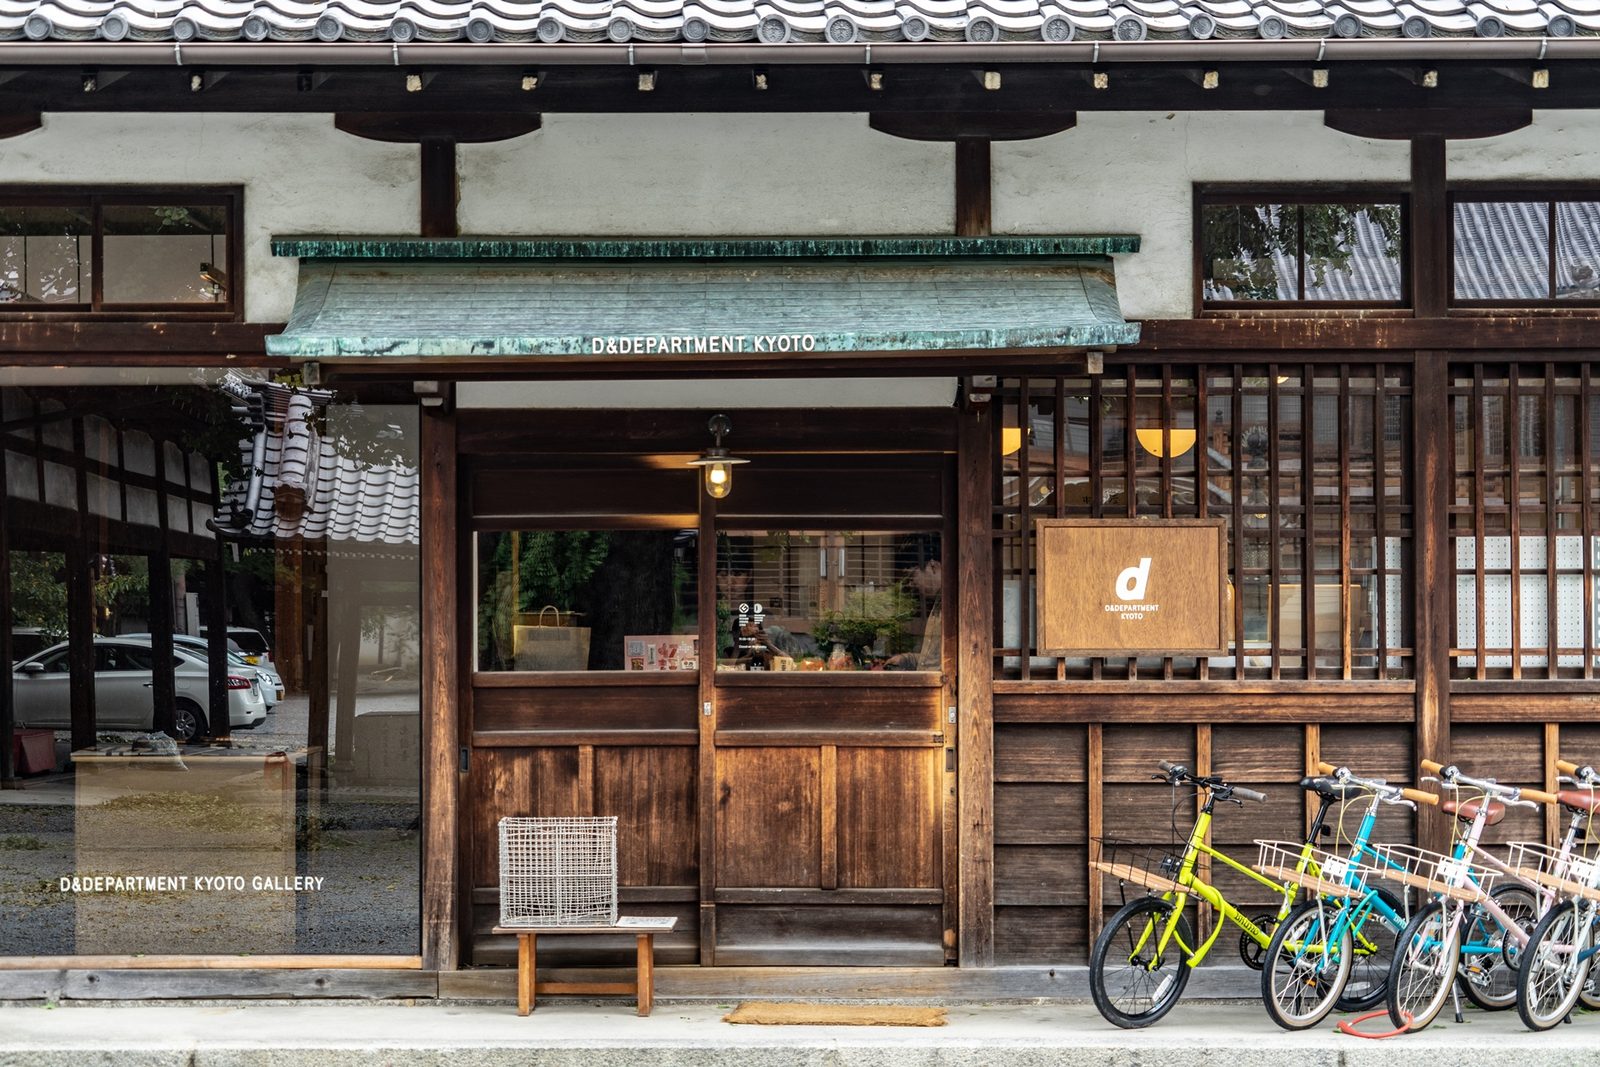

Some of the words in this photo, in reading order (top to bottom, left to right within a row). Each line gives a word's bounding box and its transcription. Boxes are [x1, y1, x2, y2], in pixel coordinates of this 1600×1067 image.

[591, 336, 745, 354] D&DEPARTMENT
[753, 335, 815, 352] KYOTO
[1115, 557, 1152, 600] d
[1104, 604, 1159, 612] D&DEPARTMENT
[60, 876, 188, 892] D&DEPARTMENT
[194, 876, 246, 891] KYOTO
[252, 876, 325, 891] GALLERY
